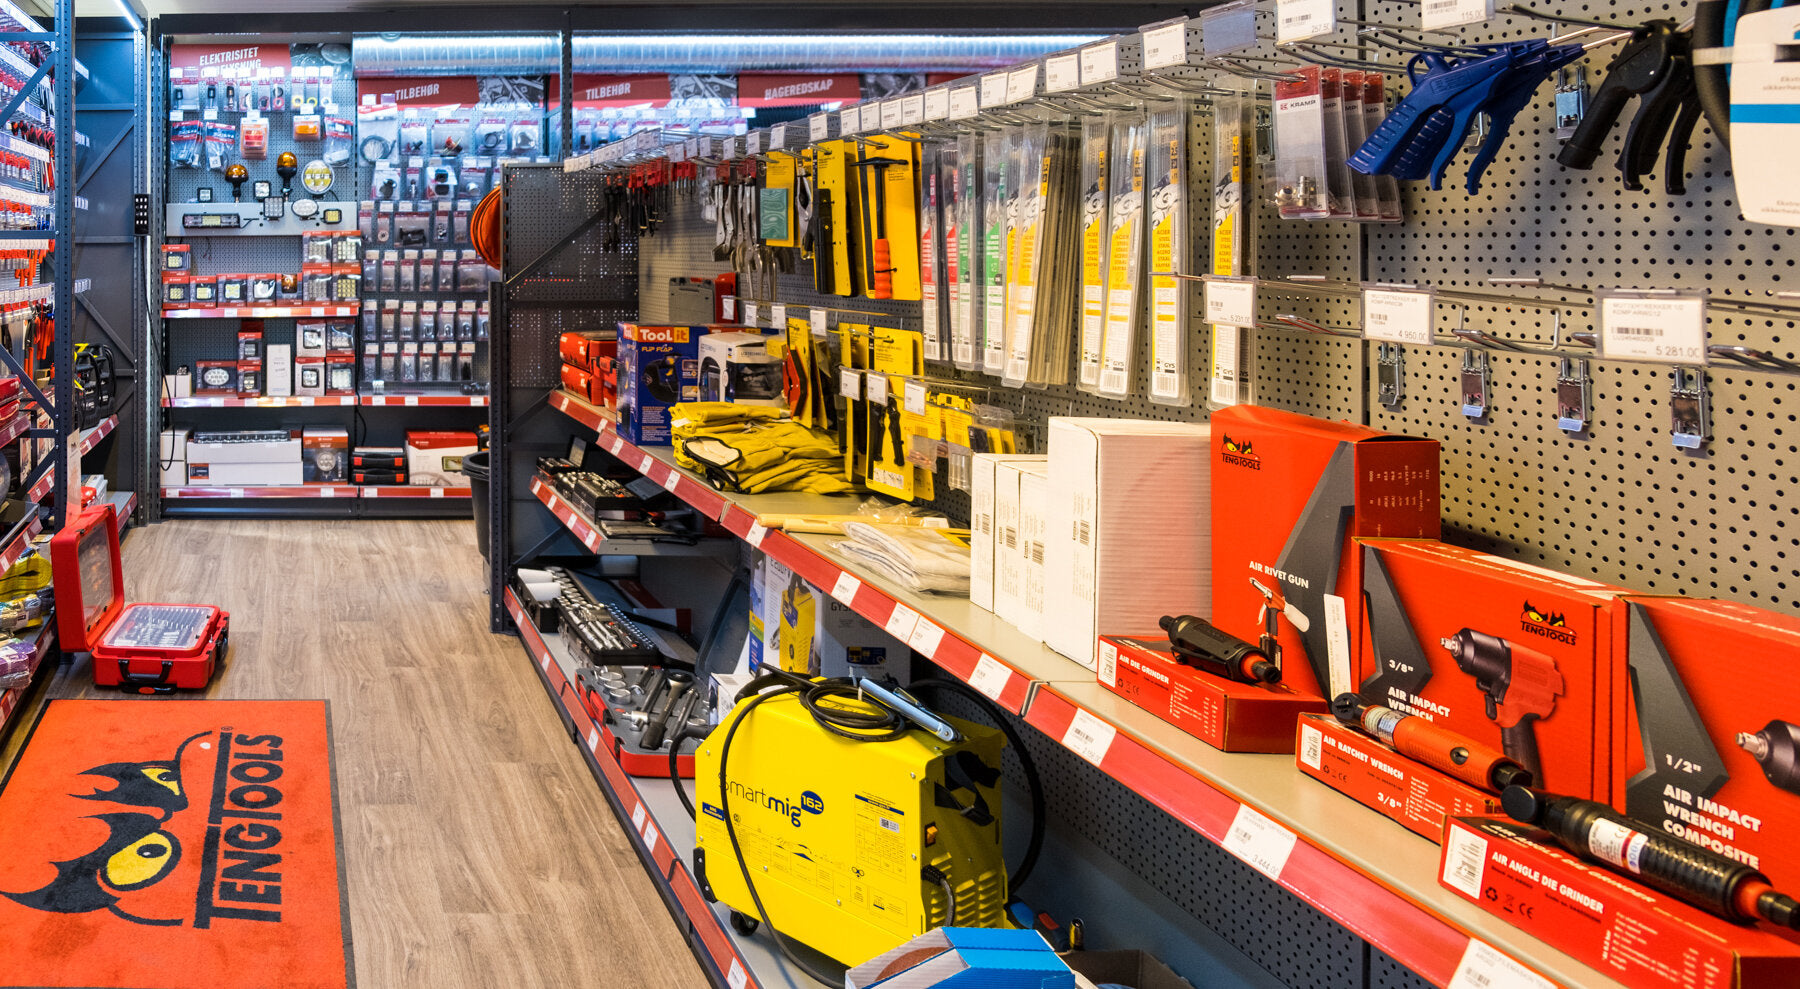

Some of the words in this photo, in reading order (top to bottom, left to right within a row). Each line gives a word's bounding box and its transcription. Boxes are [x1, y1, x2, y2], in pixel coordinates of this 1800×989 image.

[200, 47, 259, 66] ELEKTRISITET
[395, 84, 440, 100] TILBEHØR
[586, 82, 631, 100] TILBEHØR
[764, 79, 833, 101] HAGEREDSKAP
[1290, 99, 1316, 108] KRAMP
[676, 328, 687, 341] it
[1656, 346, 1662, 355] 5
[1221, 452, 1261, 471] TENGTOOLS
[1249, 560, 1263, 573] AIR
[1264, 566, 1287, 581] RIVET
[1288, 574, 1309, 589] GUN
[1520, 620, 1577, 646] TENGTOOLS
[1119, 654, 1129, 664] AIR
[1130, 659, 1141, 670] DIE
[1141, 665, 1169, 684] GRINDER
[1389, 659, 1414, 673] 3/8"
[1388, 686, 1407, 701] AIR
[1409, 694, 1450, 718] IMPACT
[1323, 735, 1336, 747] AIR
[1338, 742, 1369, 763] RATCHET
[1370, 757, 1404, 781] WRENCH
[1665, 754, 1702, 774] 1/2"
[801, 795, 823, 812] 162
[1377, 792, 1402, 808] 3/8"
[1663, 784, 1692, 805] AIR
[1697, 796, 1761, 832] IMPACT
[193, 731, 283, 929] TENGTOOLS
[1663, 800, 1734, 841] WRENCH
[1663, 820, 1759, 870] COMPOSITE
[1492, 851, 1508, 866] AIR
[1508, 860, 1540, 882] ANGLE
[1541, 875, 1558, 891] DIE
[1559, 884, 1604, 914] GRINDER
